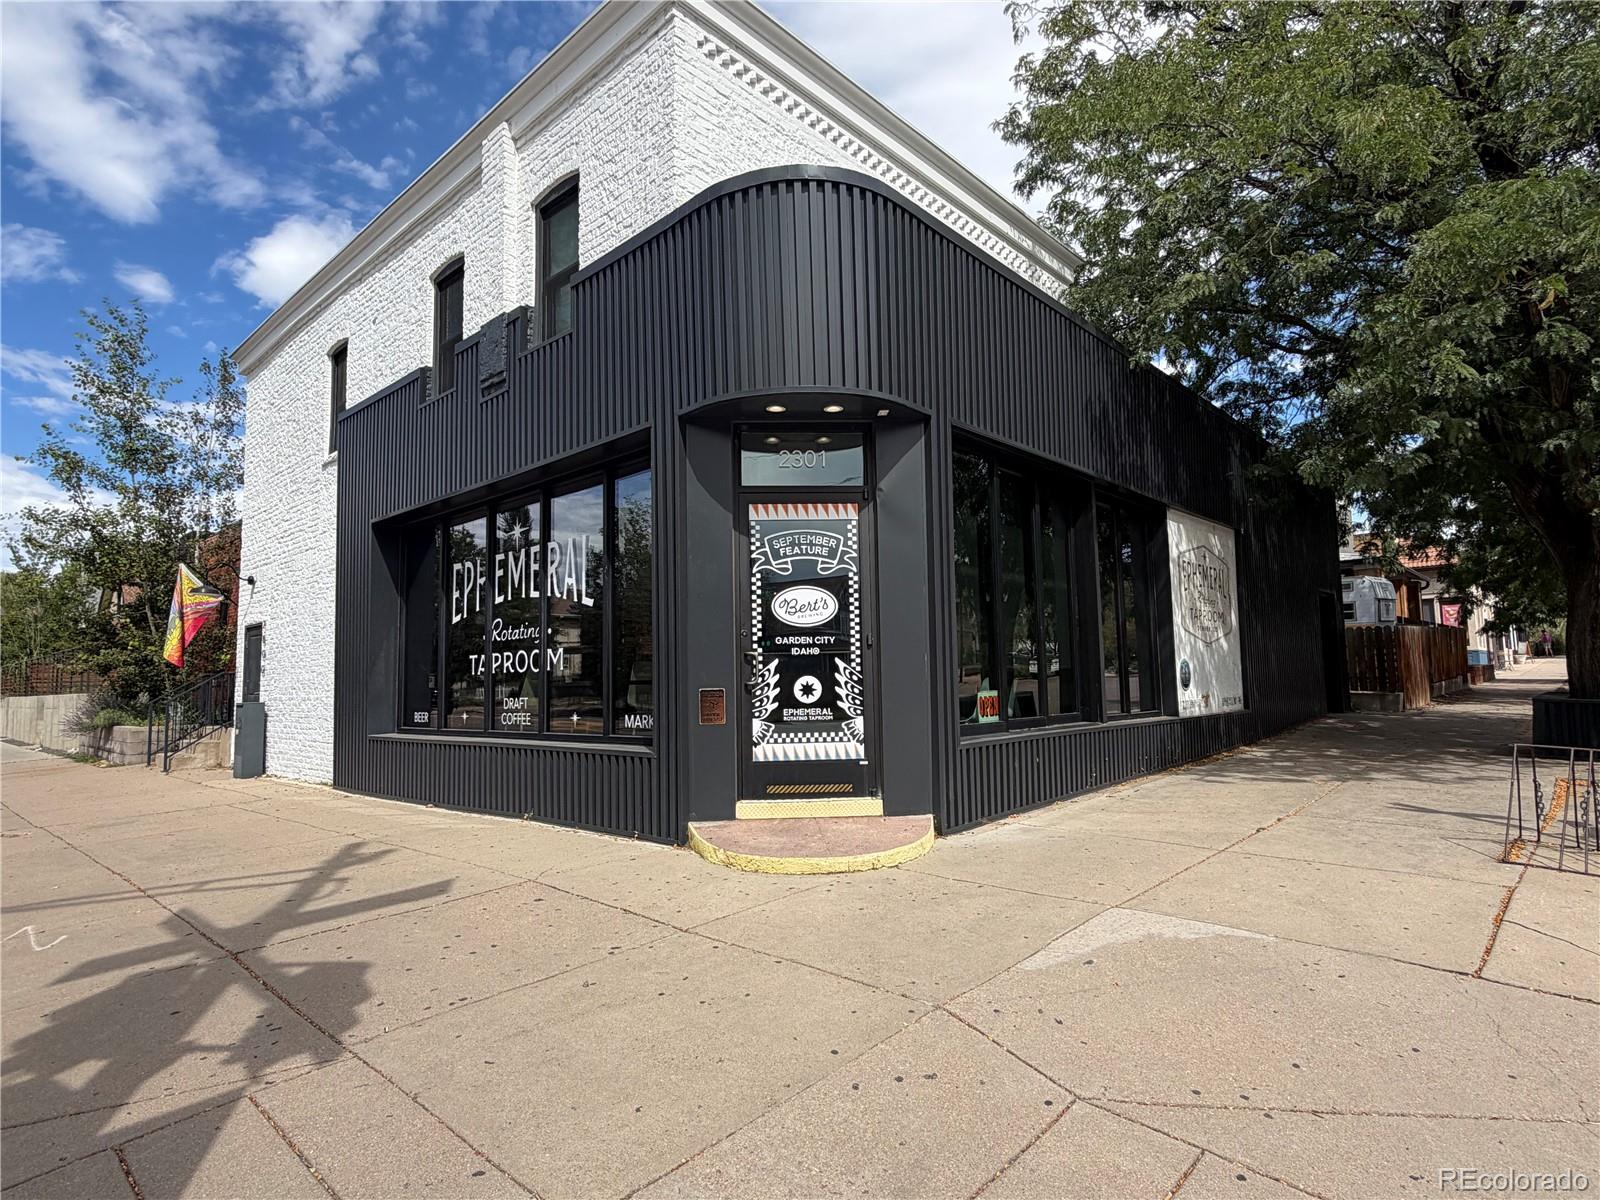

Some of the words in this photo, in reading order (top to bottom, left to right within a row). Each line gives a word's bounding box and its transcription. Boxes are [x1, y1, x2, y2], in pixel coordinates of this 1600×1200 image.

[779, 449, 826, 468] 2301
[772, 534, 837, 548] SEPTEMBER
[779, 545, 829, 556] FEATURE
[1182, 559, 1228, 600] EPHEMERAL
[778, 596, 829, 616] Bert's
[491, 617, 540, 643] Rotating
[775, 635, 813, 645] GARDEN
[814, 635, 836, 644] CITY
[791, 646, 821, 656] IDAHO
[468, 647, 564, 676] TAPROOM
[503, 697, 529, 710] DRAFT
[979, 695, 999, 718] OPEN
[413, 711, 429, 723] BEER
[783, 707, 833, 716] EPHEMERAL
[501, 712, 532, 726] COFFEE
